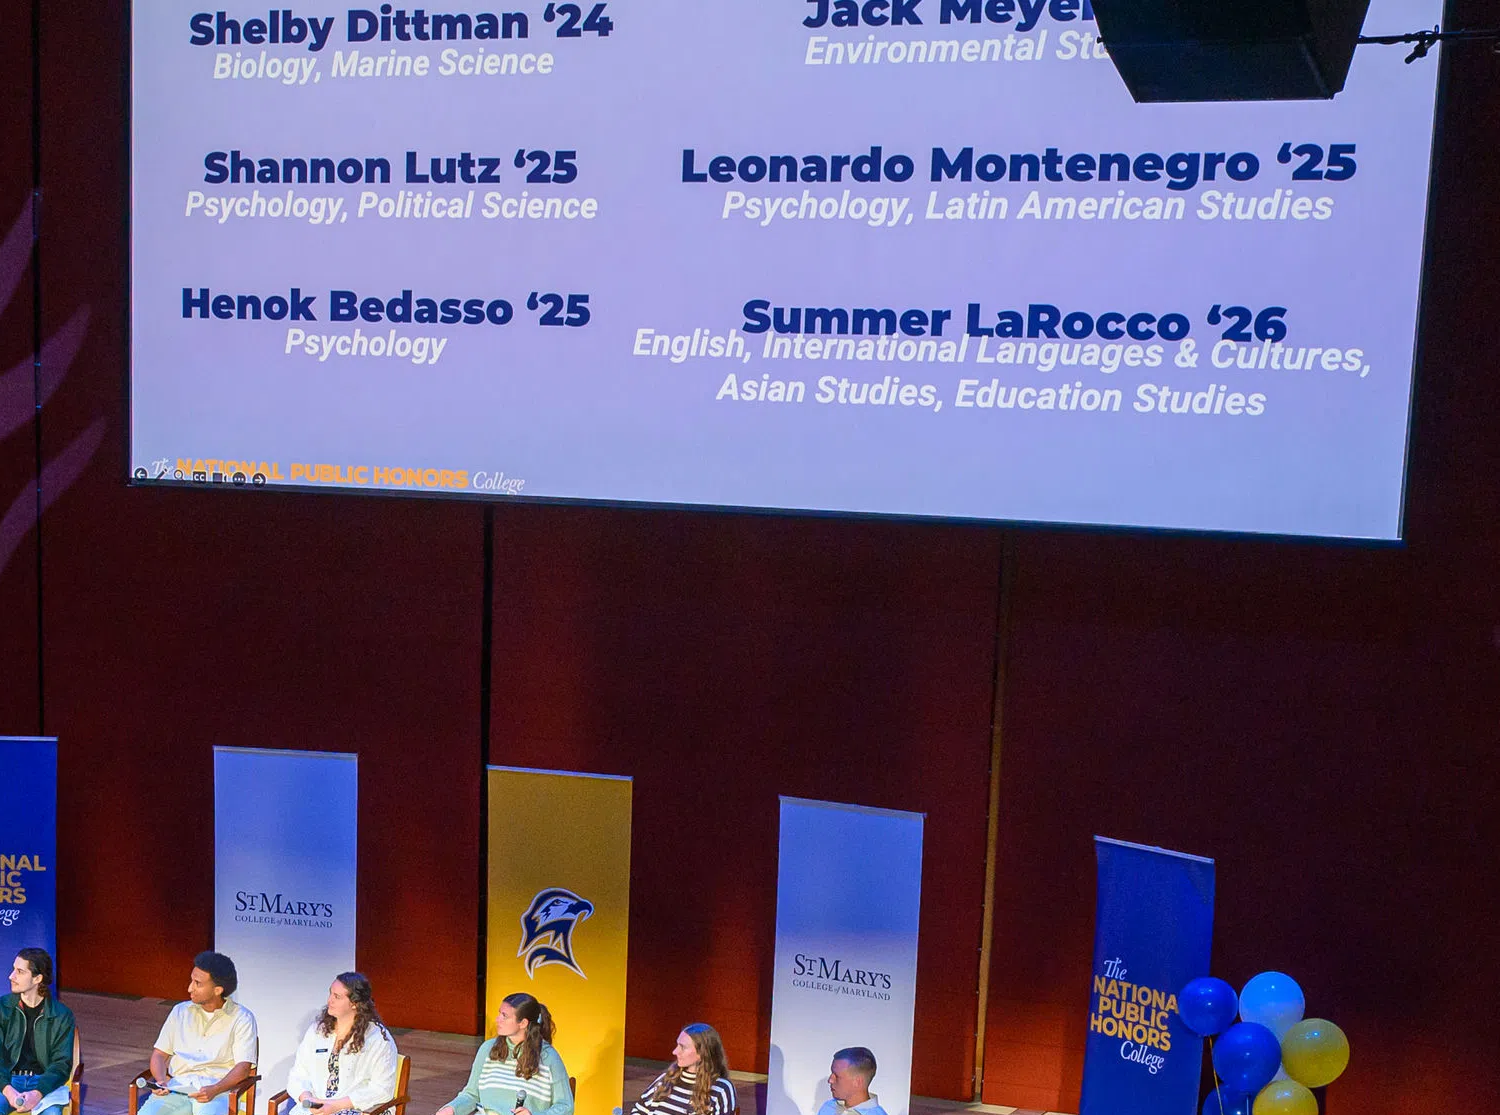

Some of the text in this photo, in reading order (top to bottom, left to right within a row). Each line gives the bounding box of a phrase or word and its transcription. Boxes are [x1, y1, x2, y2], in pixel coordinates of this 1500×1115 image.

[189, 10, 335, 52] Shelby
[348, 4, 529, 42] Dittman
[802, 0, 923, 28] Jack
[804, 29, 1048, 65] Environmental
[213, 47, 554, 85] Biology, Marine Science
[203, 150, 391, 184] Shannon
[405, 151, 501, 184] Lutz
[682, 146, 914, 182] Leonardo
[930, 147, 1260, 191] Montenegro
[185, 190, 598, 225] Psychology, Political Science
[722, 189, 1334, 227] Psychology, Latin American Studies
[182, 287, 317, 321] Henok
[330, 290, 514, 326] Bedasso
[742, 299, 951, 336] Summer
[967, 303, 1190, 341] LaRocco
[285, 328, 447, 364] Psychology
[633, 328, 1370, 378] English, International Languages & Cultures,
[716, 373, 1267, 415] Asian Studies, Education Studies
[291, 463, 368, 484] PUBLIC
[374, 465, 468, 488] HONORS
[473, 470, 525, 495] College
[235, 914, 333, 928] COLLEGE of MARYLAND
[1104, 957, 1127, 980] The
[793, 979, 891, 1001] COLLEGE of MARYLAND
[1094, 974, 1179, 1014] NATIONA
[1099, 996, 1169, 1030] PUBLIC
[1090, 1012, 1171, 1051] HONORS
[1120, 1040, 1165, 1075] College
